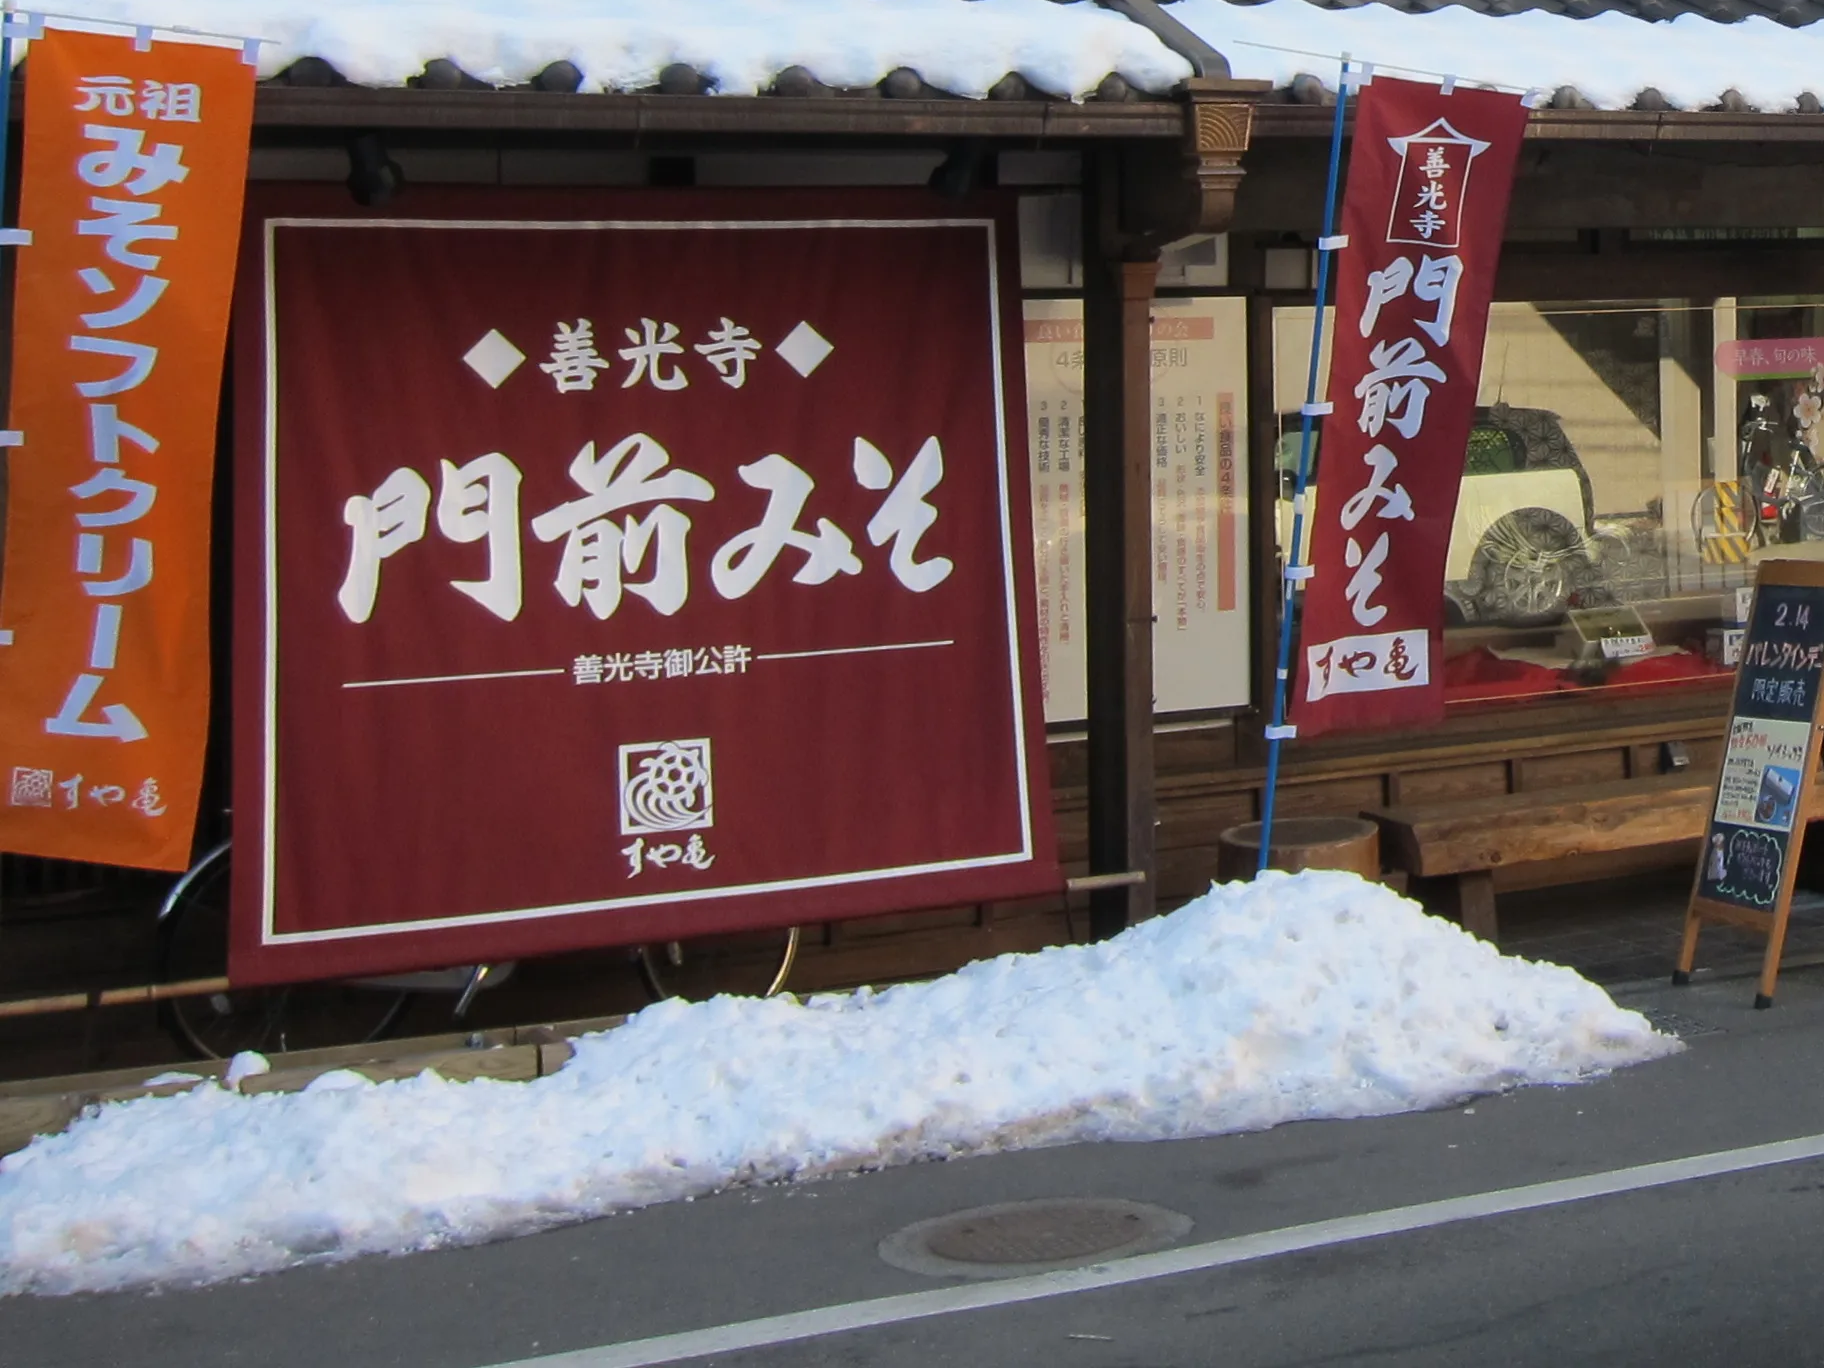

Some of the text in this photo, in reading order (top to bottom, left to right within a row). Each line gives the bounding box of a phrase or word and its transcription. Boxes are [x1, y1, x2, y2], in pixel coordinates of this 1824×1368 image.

[74, 75, 202, 124] 元祖
[1410, 146, 1450, 239] 善光寺
[540, 317, 762, 394] 善光寺
[45, 124, 191, 742] みそソフトクリーム
[1340, 254, 1464, 626] 門前みそ
[337, 432, 953, 623] 門前みそ
[1774, 602, 1811, 630] 2.14
[572, 644, 752, 685] 善光寺御公許
[1316, 635, 1418, 688] すや亀
[1751, 677, 1806, 707] 限定販売
[59, 774, 168, 817] すや亀
[620, 834, 716, 879] すや亀
